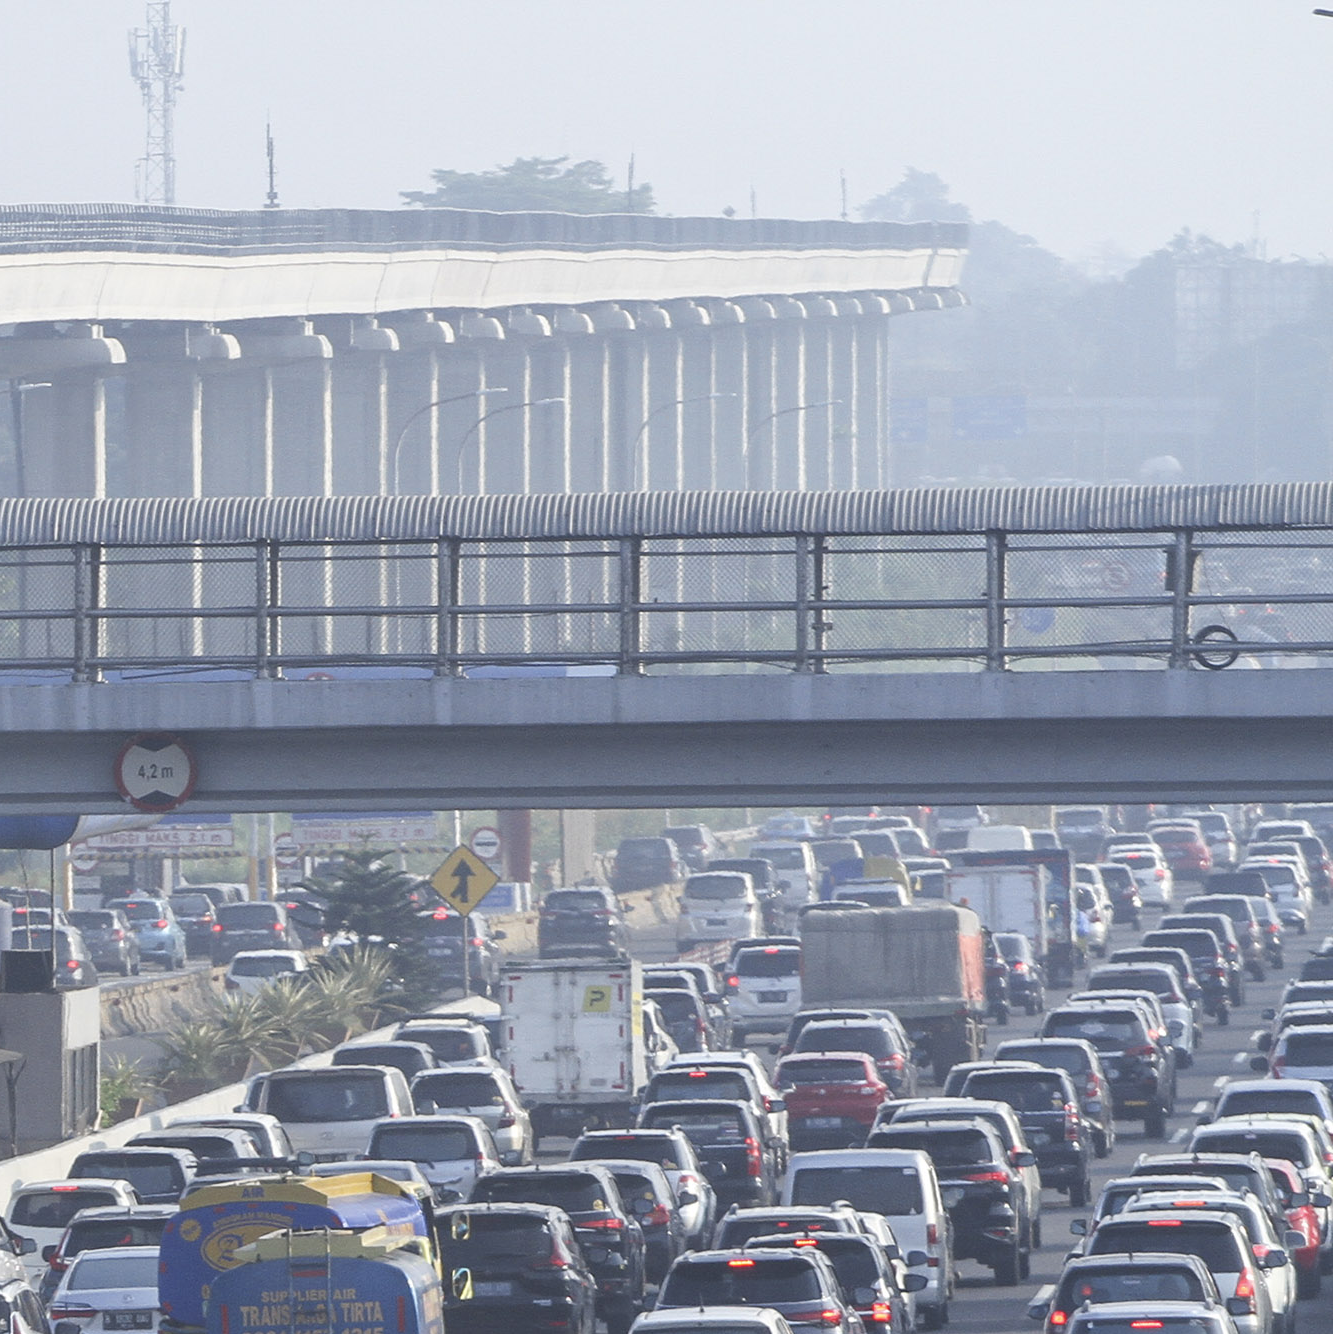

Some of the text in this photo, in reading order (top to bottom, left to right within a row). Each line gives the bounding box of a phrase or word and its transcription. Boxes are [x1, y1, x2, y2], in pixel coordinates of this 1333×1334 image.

[161, 769, 174, 778] m
[242, 1187, 265, 1199] AIR
[261, 1288, 357, 1303] SUPPLIER AIR
[240, 1304, 291, 1327] TRANS
[340, 1301, 383, 1323] TIRTA
